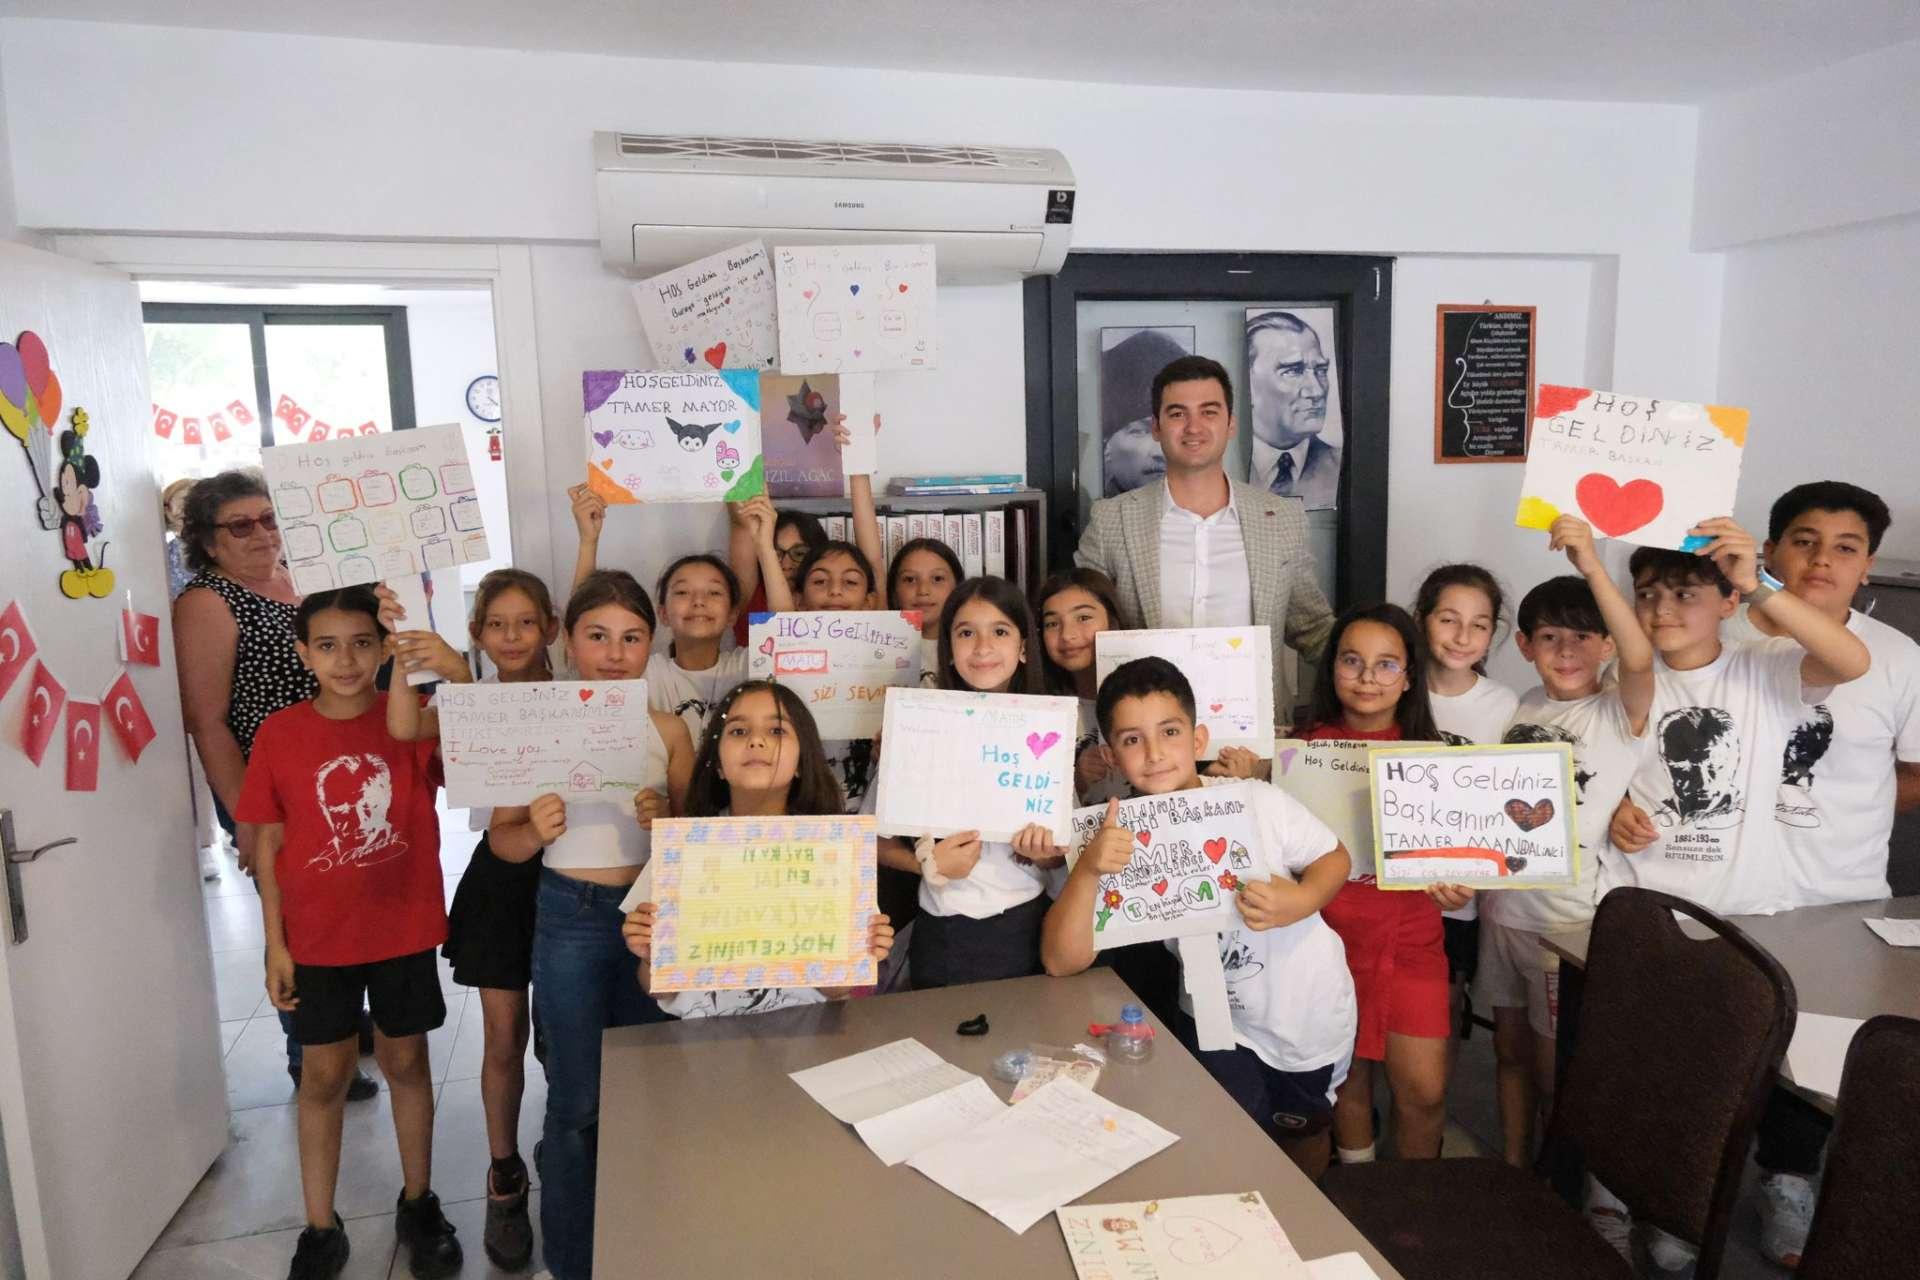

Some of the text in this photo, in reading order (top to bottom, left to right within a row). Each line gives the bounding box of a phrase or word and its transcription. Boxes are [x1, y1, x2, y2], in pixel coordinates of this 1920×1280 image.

[607, 399, 672, 415] TAMER
[1386, 761, 1557, 792] HOŞ Geldiniz
[1384, 833, 1454, 849] TAMER
